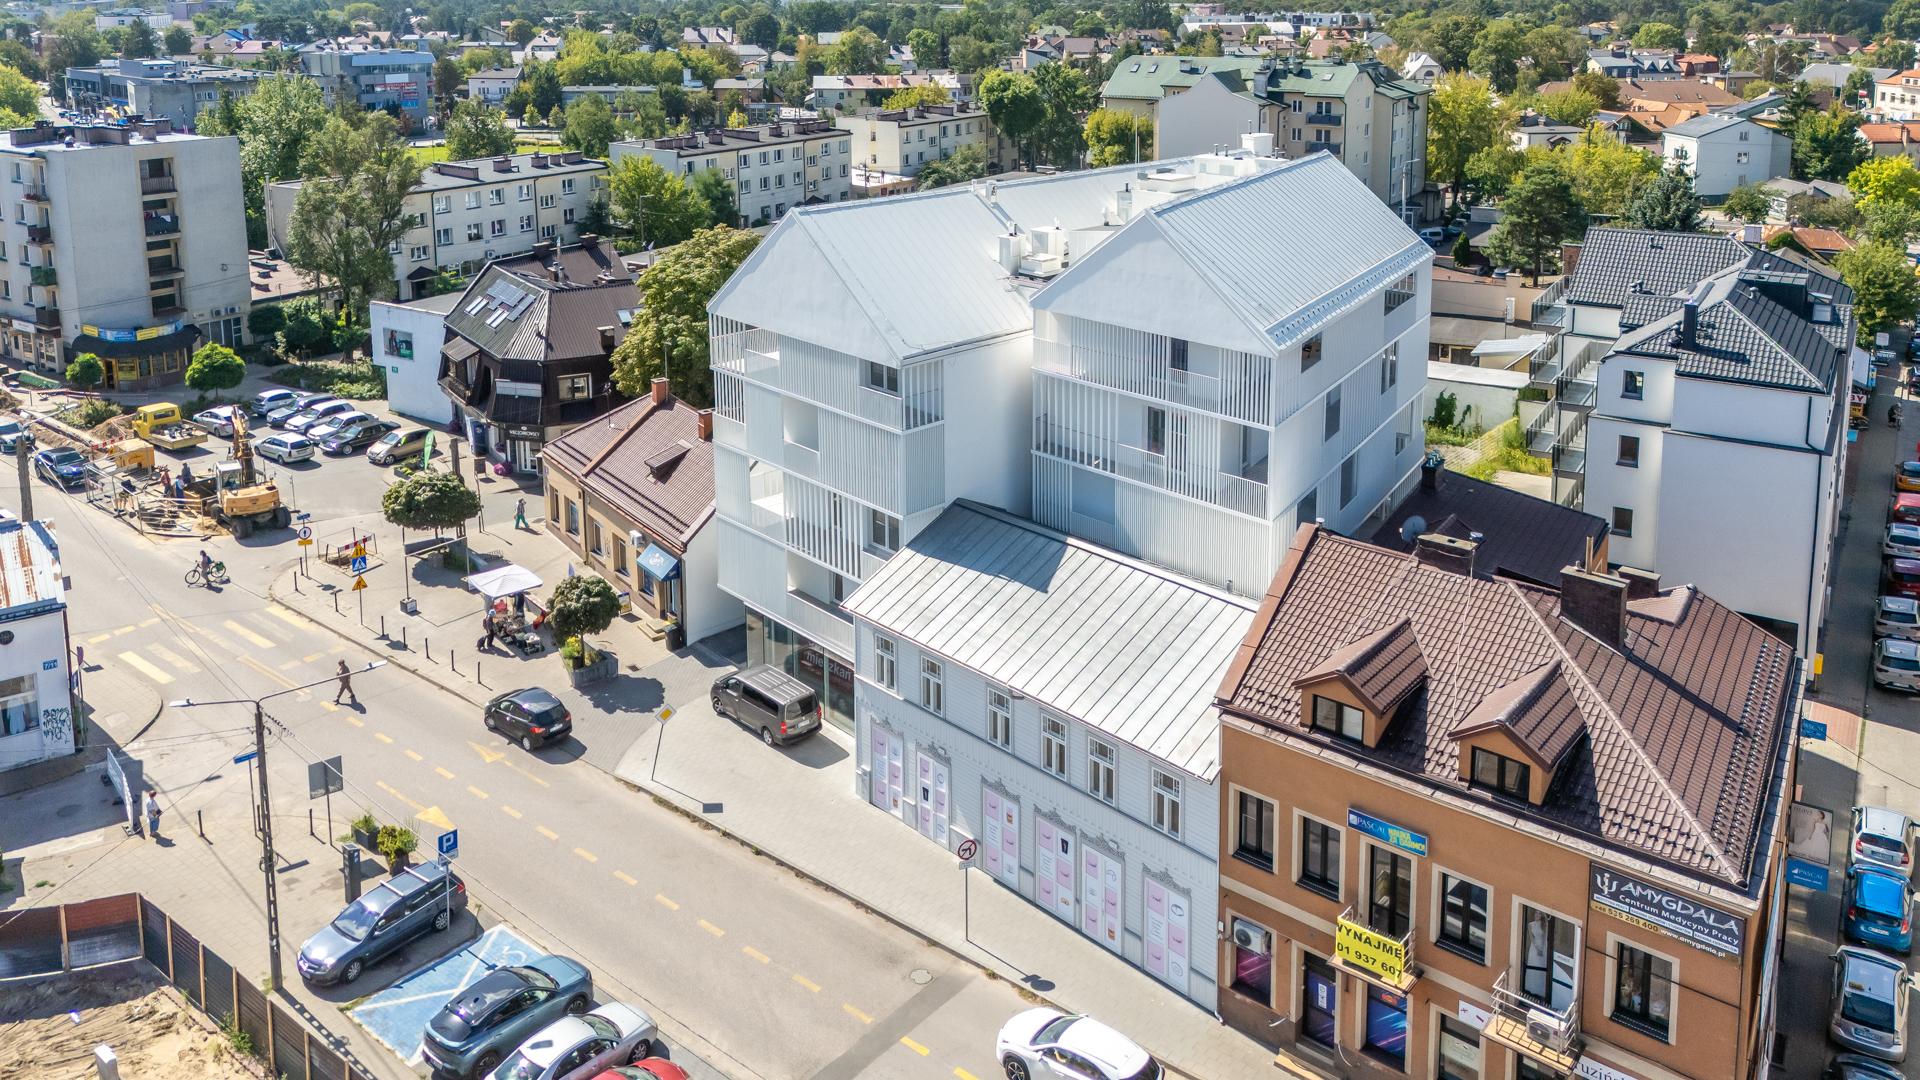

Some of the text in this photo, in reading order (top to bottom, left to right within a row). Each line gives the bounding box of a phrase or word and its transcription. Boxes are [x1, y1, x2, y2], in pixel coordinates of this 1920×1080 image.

[443, 833, 454, 852] P
[1619, 894, 1659, 915] Centrum
[1661, 909, 1709, 934] Medycyny
[1712, 929, 1739, 946] Pracy
[1620, 882, 1739, 935] AMYGDALA
[1642, 921, 1658, 933] 400
[1660, 929, 1726, 958] www.amygdala.pl
[1354, 950, 1377, 966] 937
[1381, 962, 1402, 979] 607
